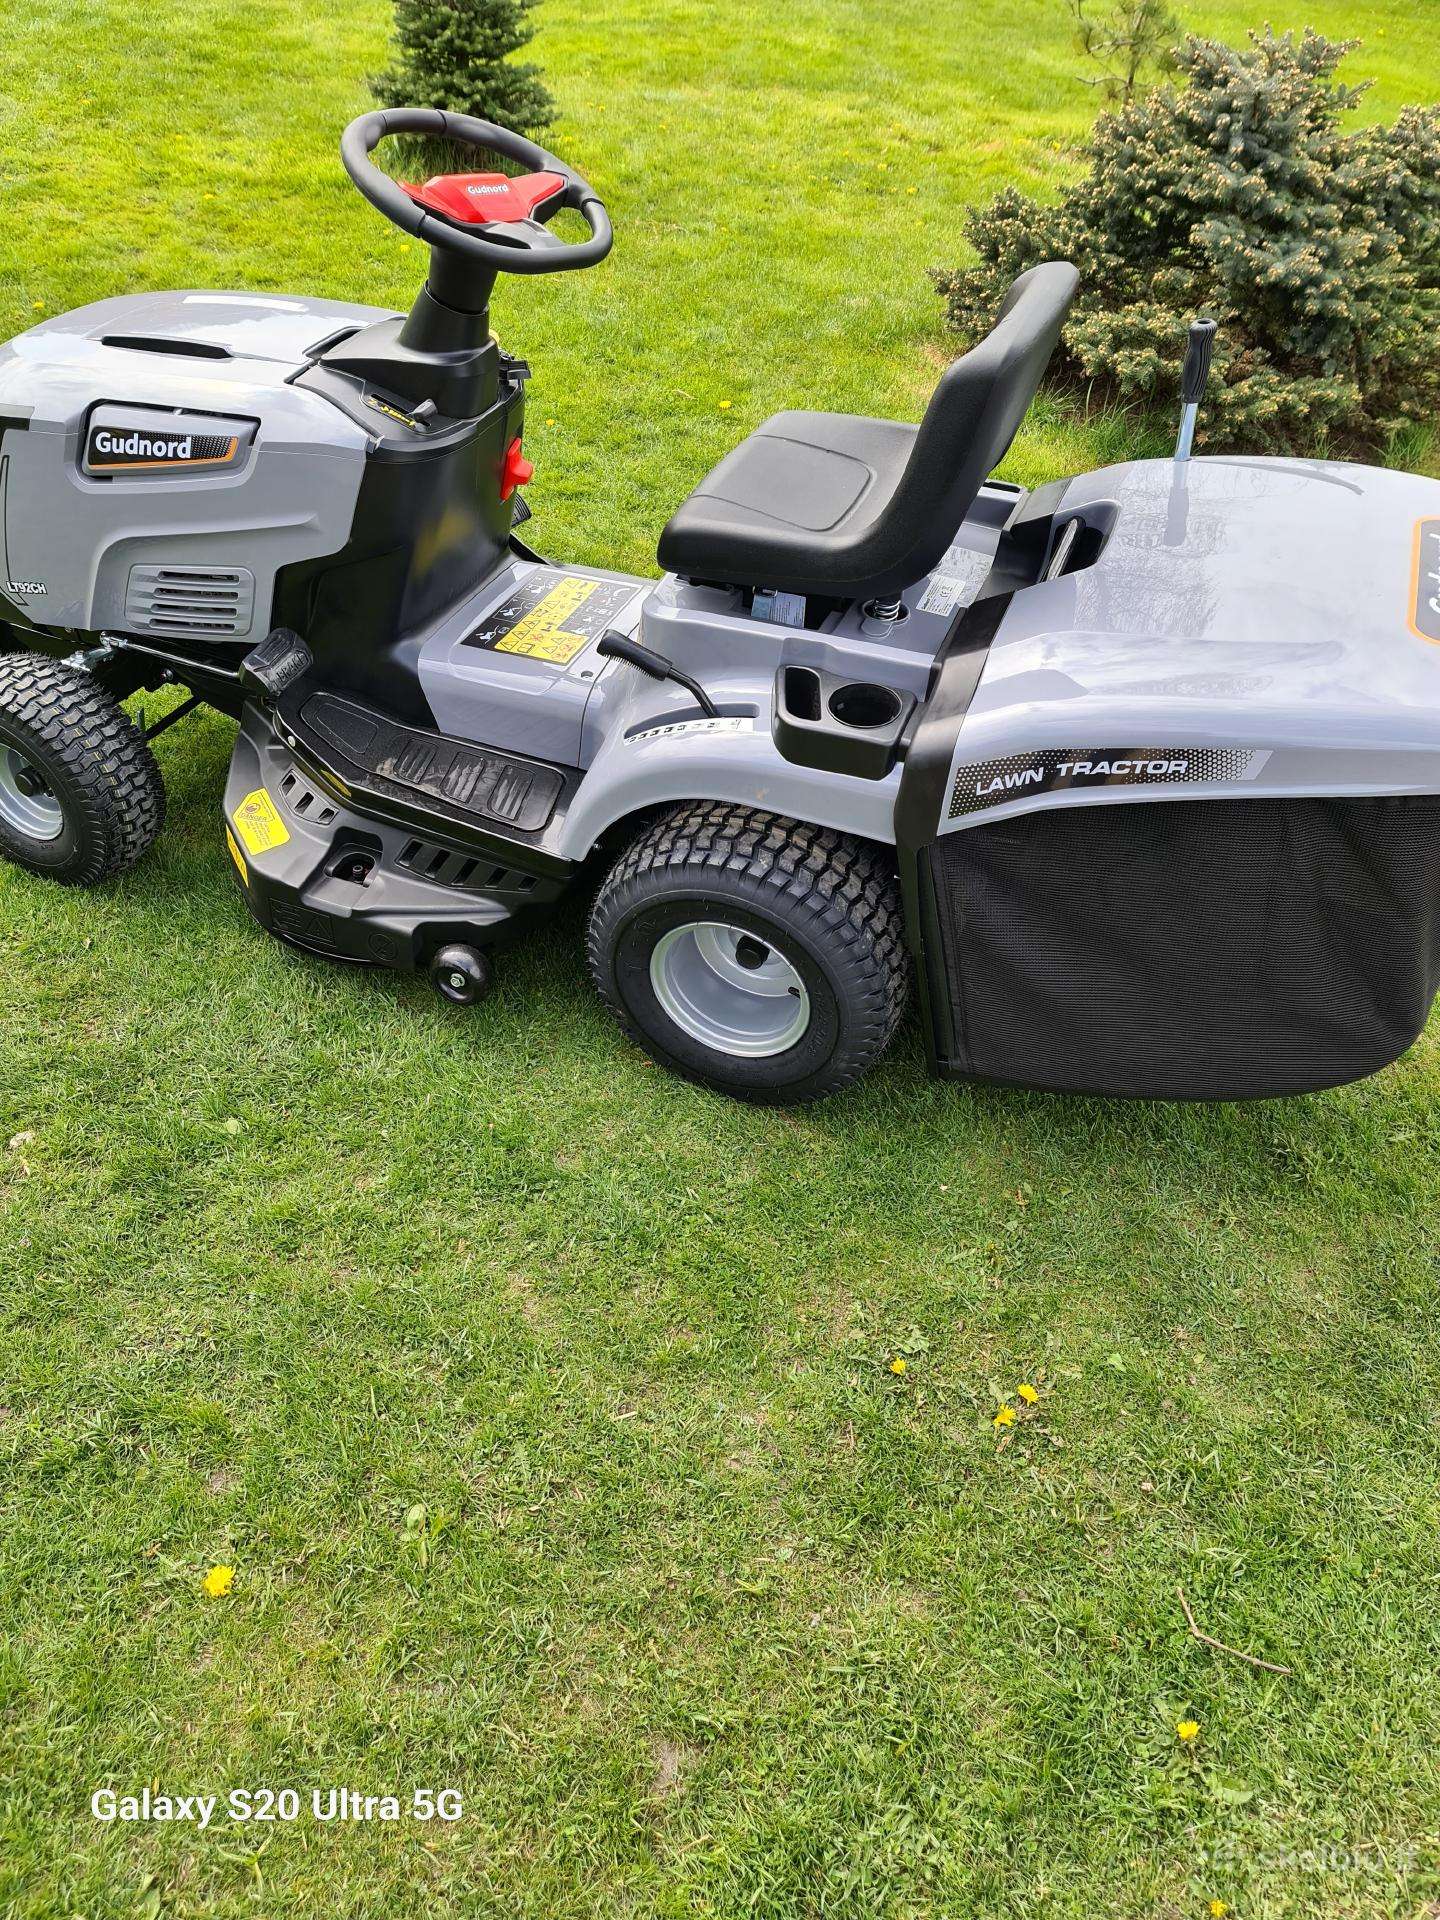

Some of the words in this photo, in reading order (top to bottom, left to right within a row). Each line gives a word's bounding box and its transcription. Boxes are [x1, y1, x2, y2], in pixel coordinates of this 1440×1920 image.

[467, 184, 509, 195] Gudnord
[95, 432, 192, 459] Gudnord
[6, 581, 48, 594] LT92CH
[975, 766, 1044, 796] LAWN
[1055, 760, 1190, 777] TRACTOR
